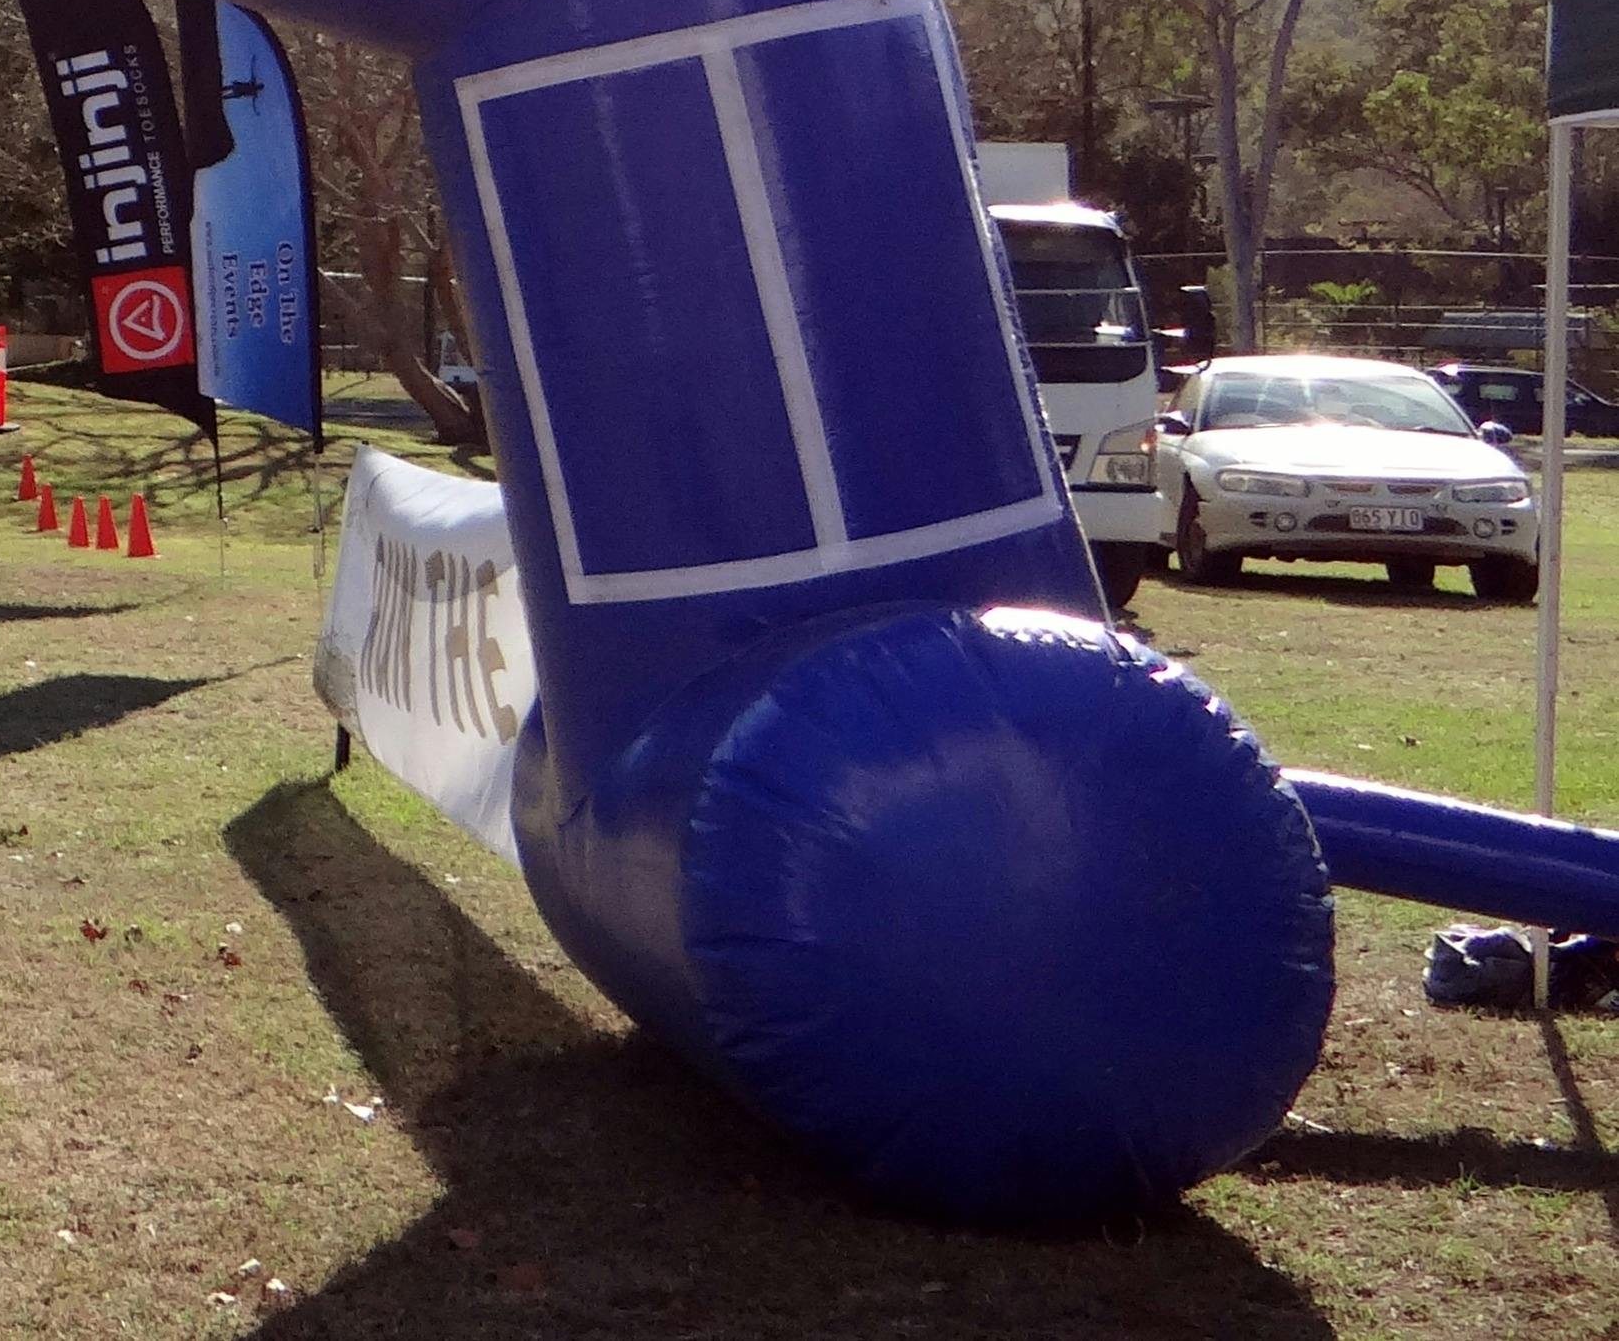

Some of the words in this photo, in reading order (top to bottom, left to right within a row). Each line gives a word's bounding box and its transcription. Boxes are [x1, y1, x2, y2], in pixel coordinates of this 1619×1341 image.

[124, 44, 156, 143] TOESOCKS
[56, 50, 147, 263] injinji
[147, 151, 176, 255] PERFORMANCE
[222, 253, 240, 339] Events
[247, 259, 269, 328] Edge
[278, 241, 294, 285] On
[279, 289, 299, 344] The
[426, 548, 518, 746] THE
